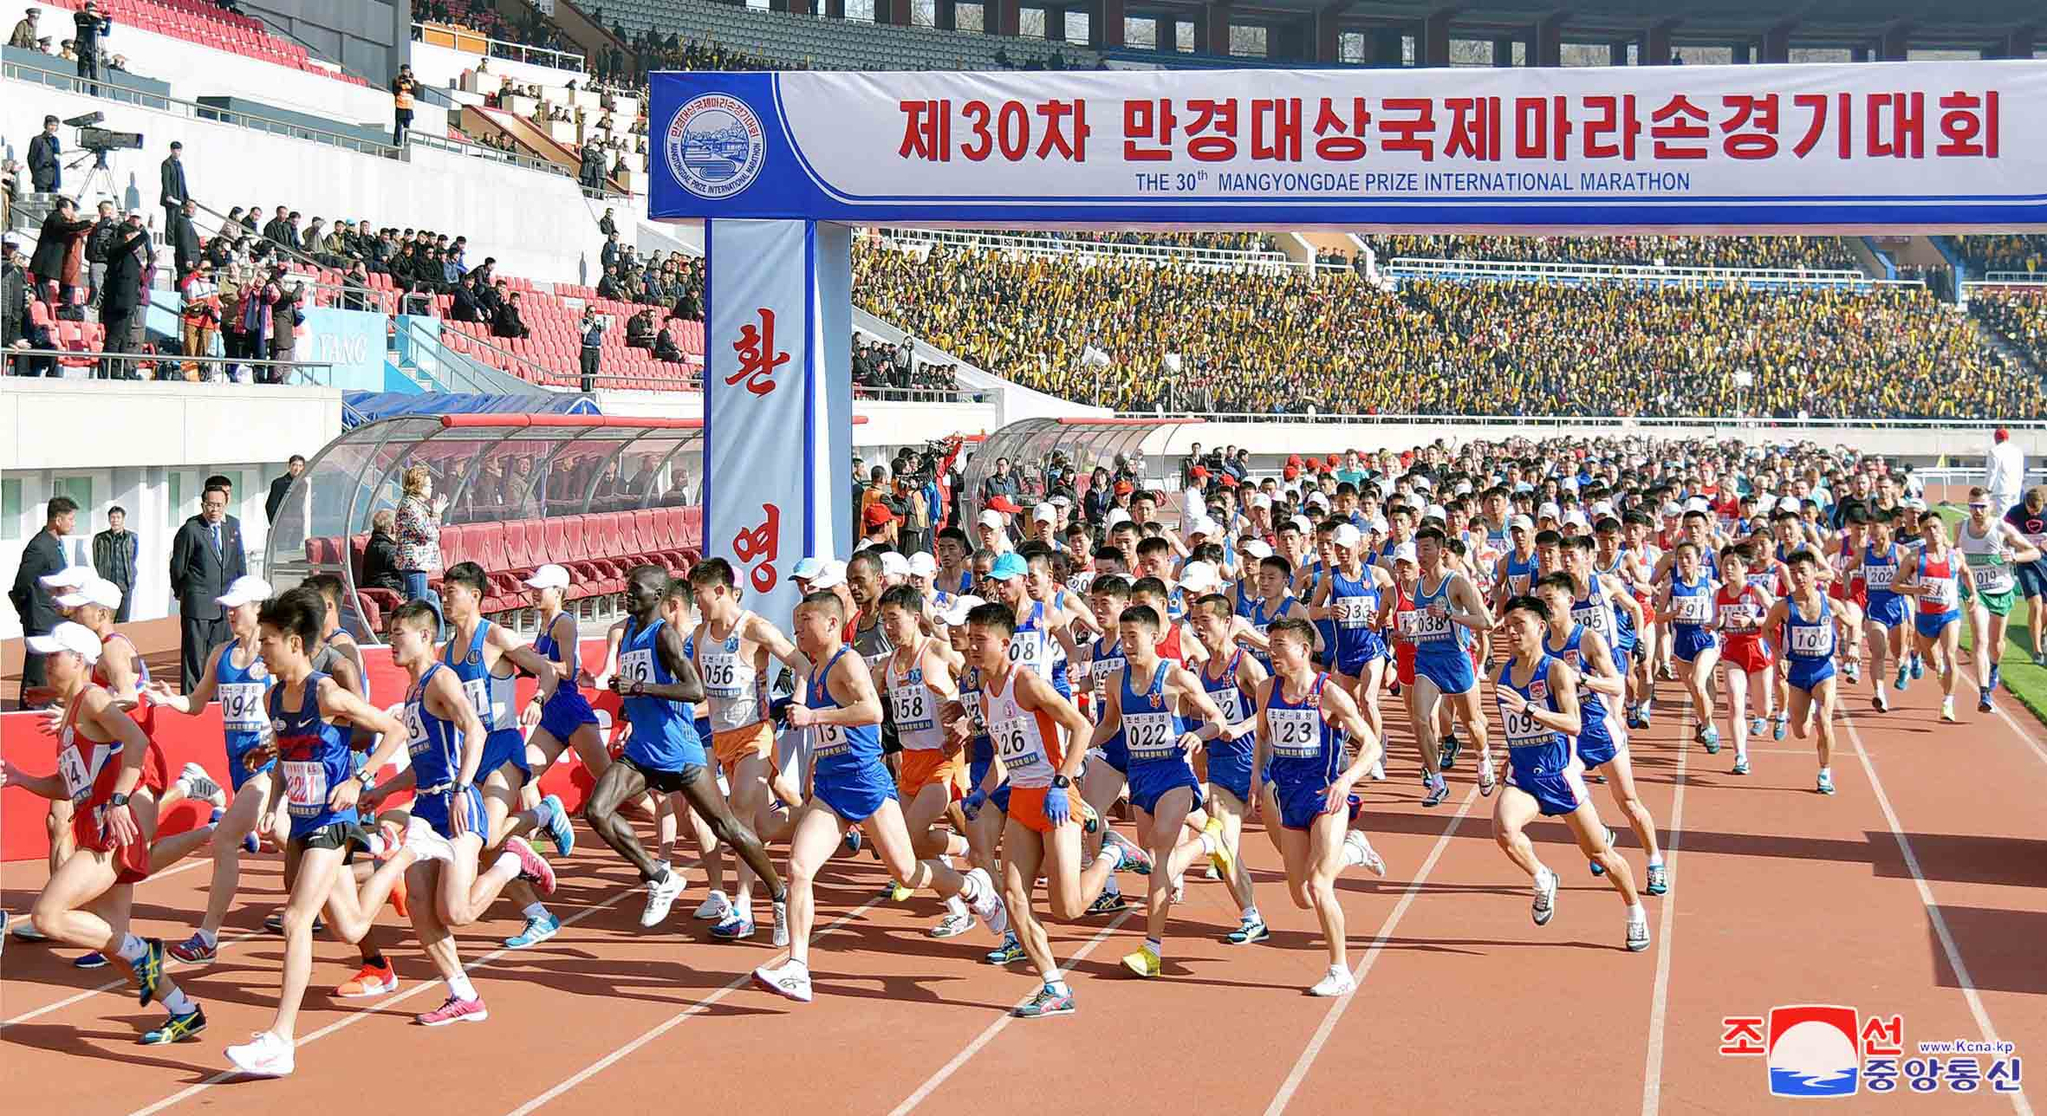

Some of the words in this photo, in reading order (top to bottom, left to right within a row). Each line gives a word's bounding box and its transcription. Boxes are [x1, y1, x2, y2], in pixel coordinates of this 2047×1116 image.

[898, 98, 1090, 162] 제30차
[1123, 90, 2000, 162] 만경대상국제마라손경기대회
[1136, 173, 1169, 191] THE
[1176, 170, 1208, 191] 30th
[1218, 173, 1359, 191] MANGYONGDAE
[1365, 173, 1418, 191] PRIZE
[1425, 173, 1574, 191] INTERNATIONAL
[1581, 172, 1690, 191] MARATHON
[705, 664, 734, 684] 056
[223, 695, 258, 717] 094
[893, 696, 923, 720] 058
[1130, 724, 1166, 746] 022
[1273, 720, 1312, 743] 123
